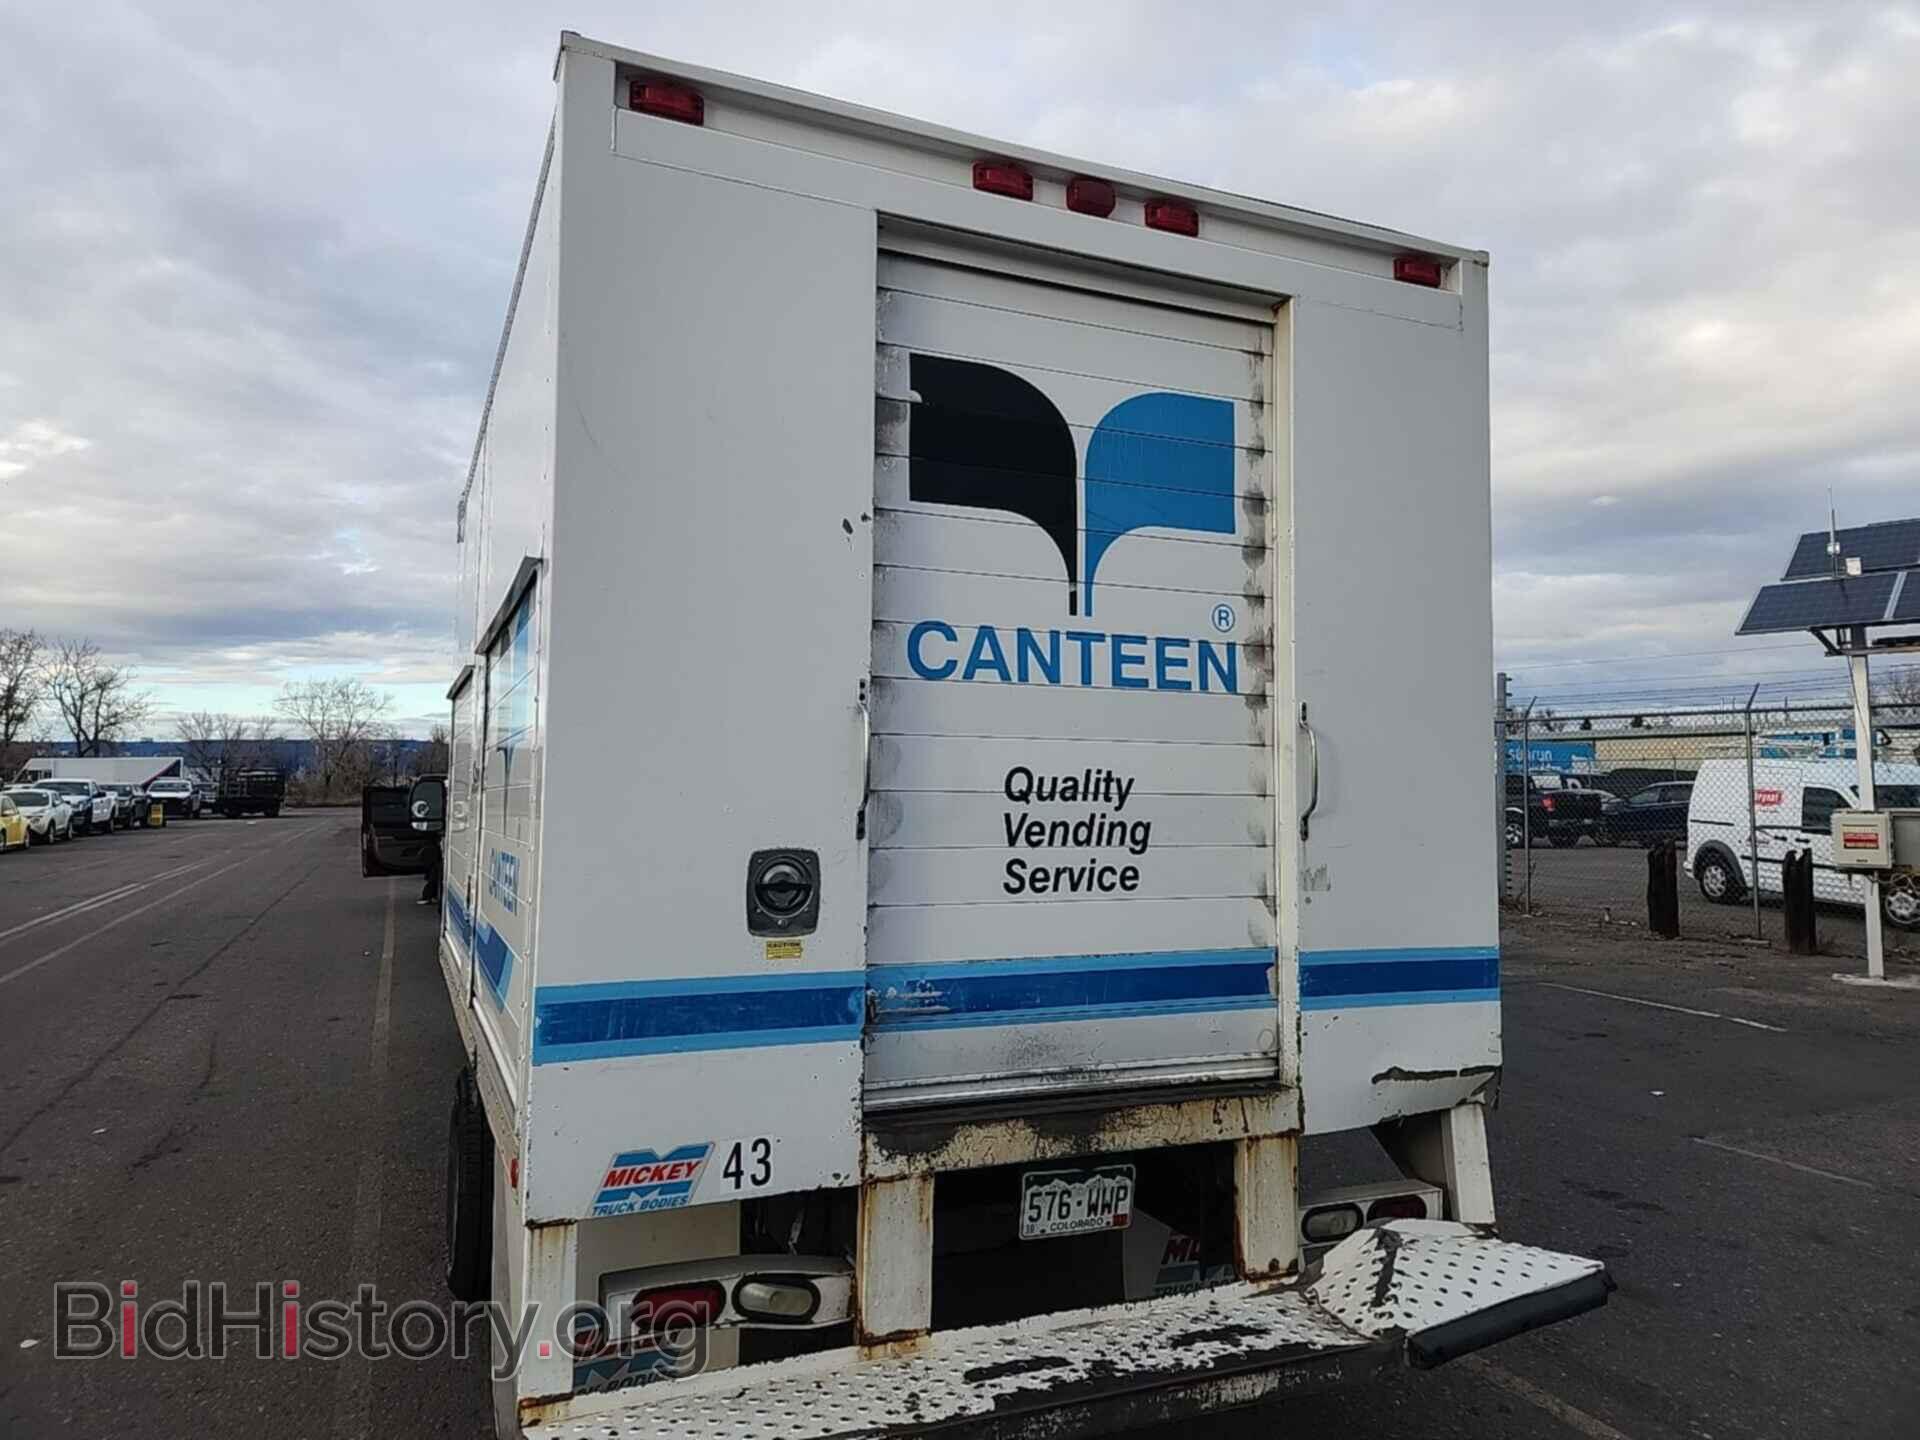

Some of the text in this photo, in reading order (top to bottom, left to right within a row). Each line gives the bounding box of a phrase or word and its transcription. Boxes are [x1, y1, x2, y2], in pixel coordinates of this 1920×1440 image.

[907, 620, 1239, 694] CANTEEN
[1004, 766, 1135, 811] Quality
[1003, 813, 1152, 855] Vending
[1003, 858, 1140, 894] Service
[603, 1160, 703, 1188] MICKEY
[723, 1137, 772, 1190] 43
[592, 1195, 689, 1216] TRUCK BODIES
[1050, 1217, 1104, 1232] COLORADO
